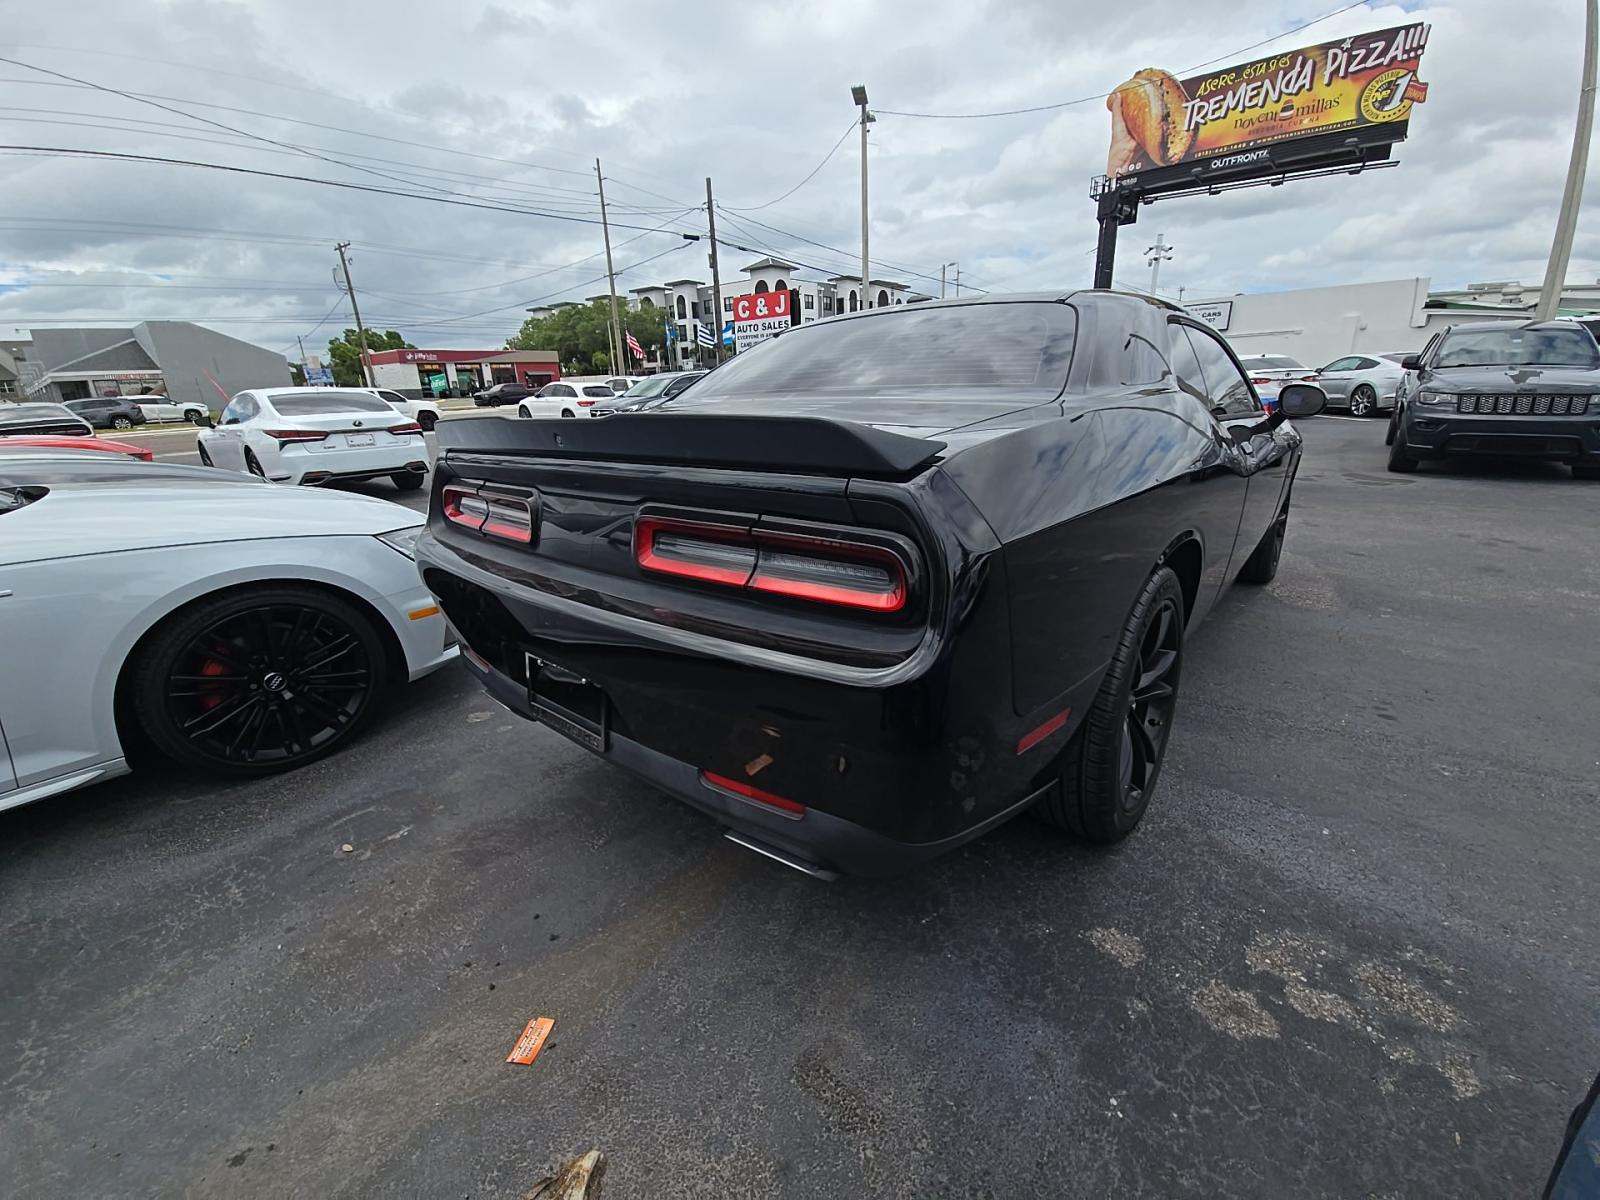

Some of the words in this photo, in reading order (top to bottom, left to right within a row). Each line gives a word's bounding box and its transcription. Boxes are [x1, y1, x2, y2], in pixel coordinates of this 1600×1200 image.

[738, 300, 749, 318] C
[755, 298, 768, 316] &
[775, 295, 785, 313] J
[737, 323, 759, 333] AUTO
[761, 319, 789, 331] SALES
